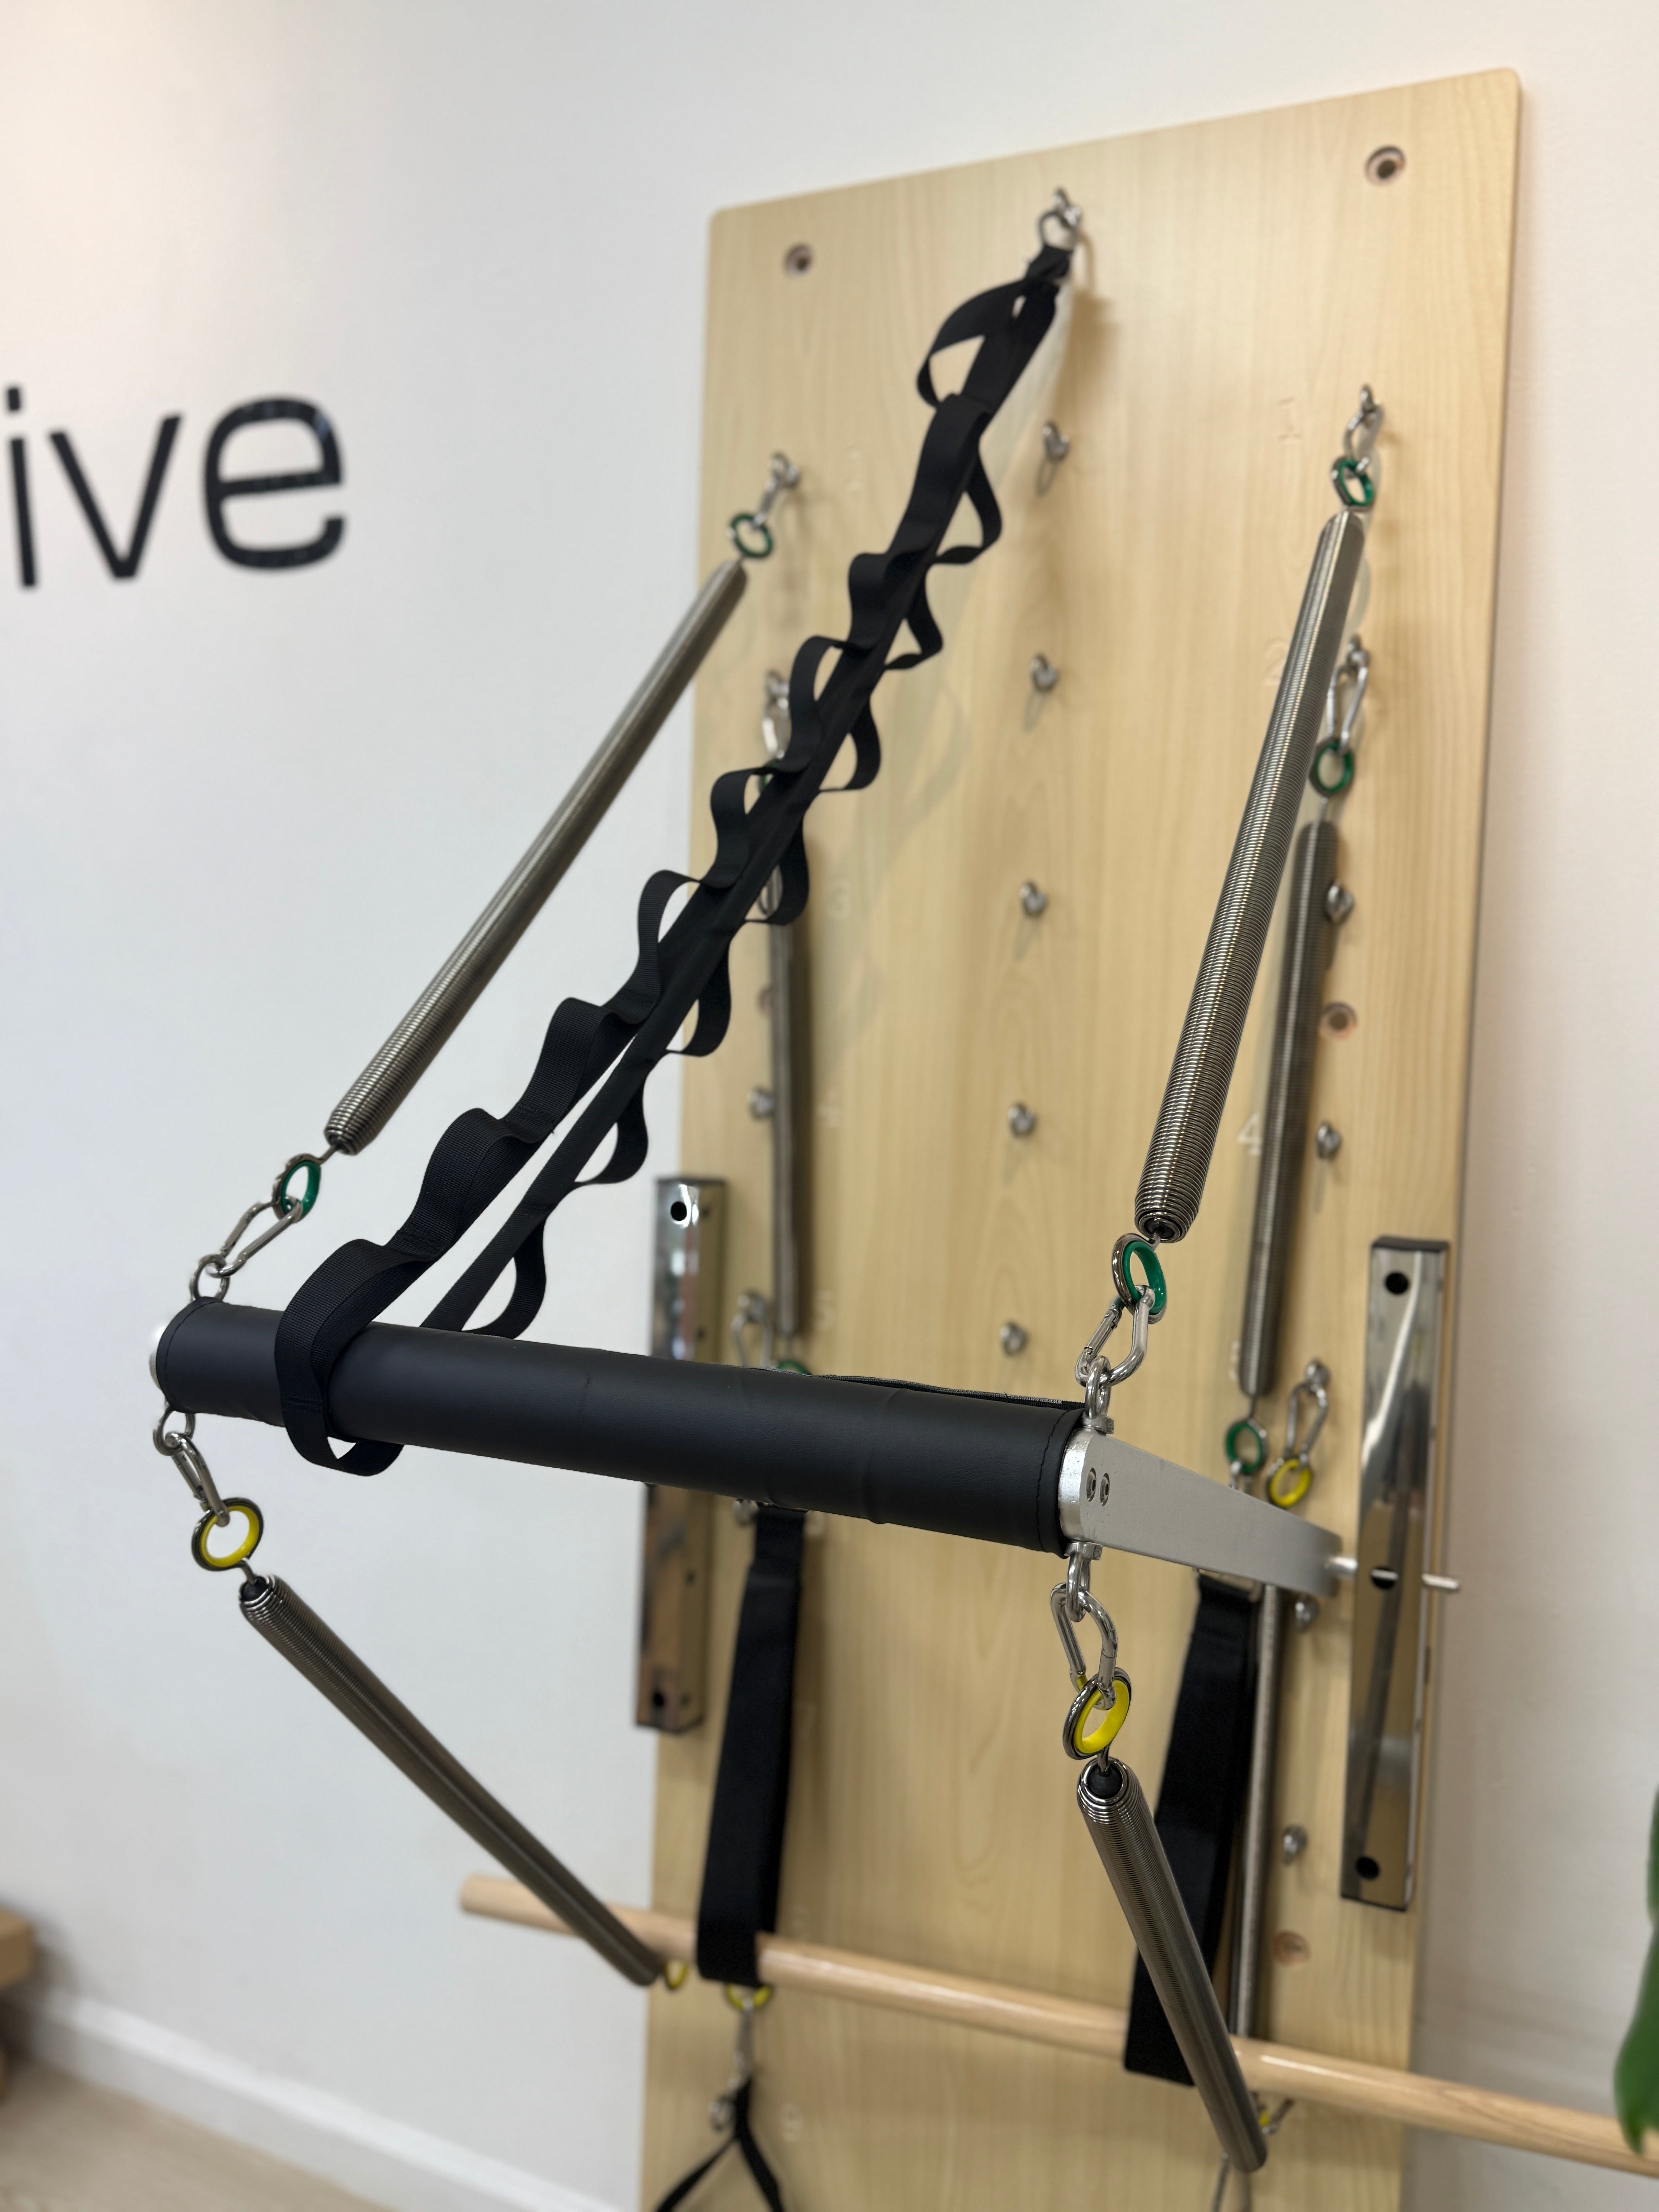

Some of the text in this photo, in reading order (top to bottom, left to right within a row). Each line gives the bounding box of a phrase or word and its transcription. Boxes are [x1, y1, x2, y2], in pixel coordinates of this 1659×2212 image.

[1277, 395, 1304, 444] 1
[7, 386, 345, 587] ive
[1237, 1111, 1263, 1157] 4
